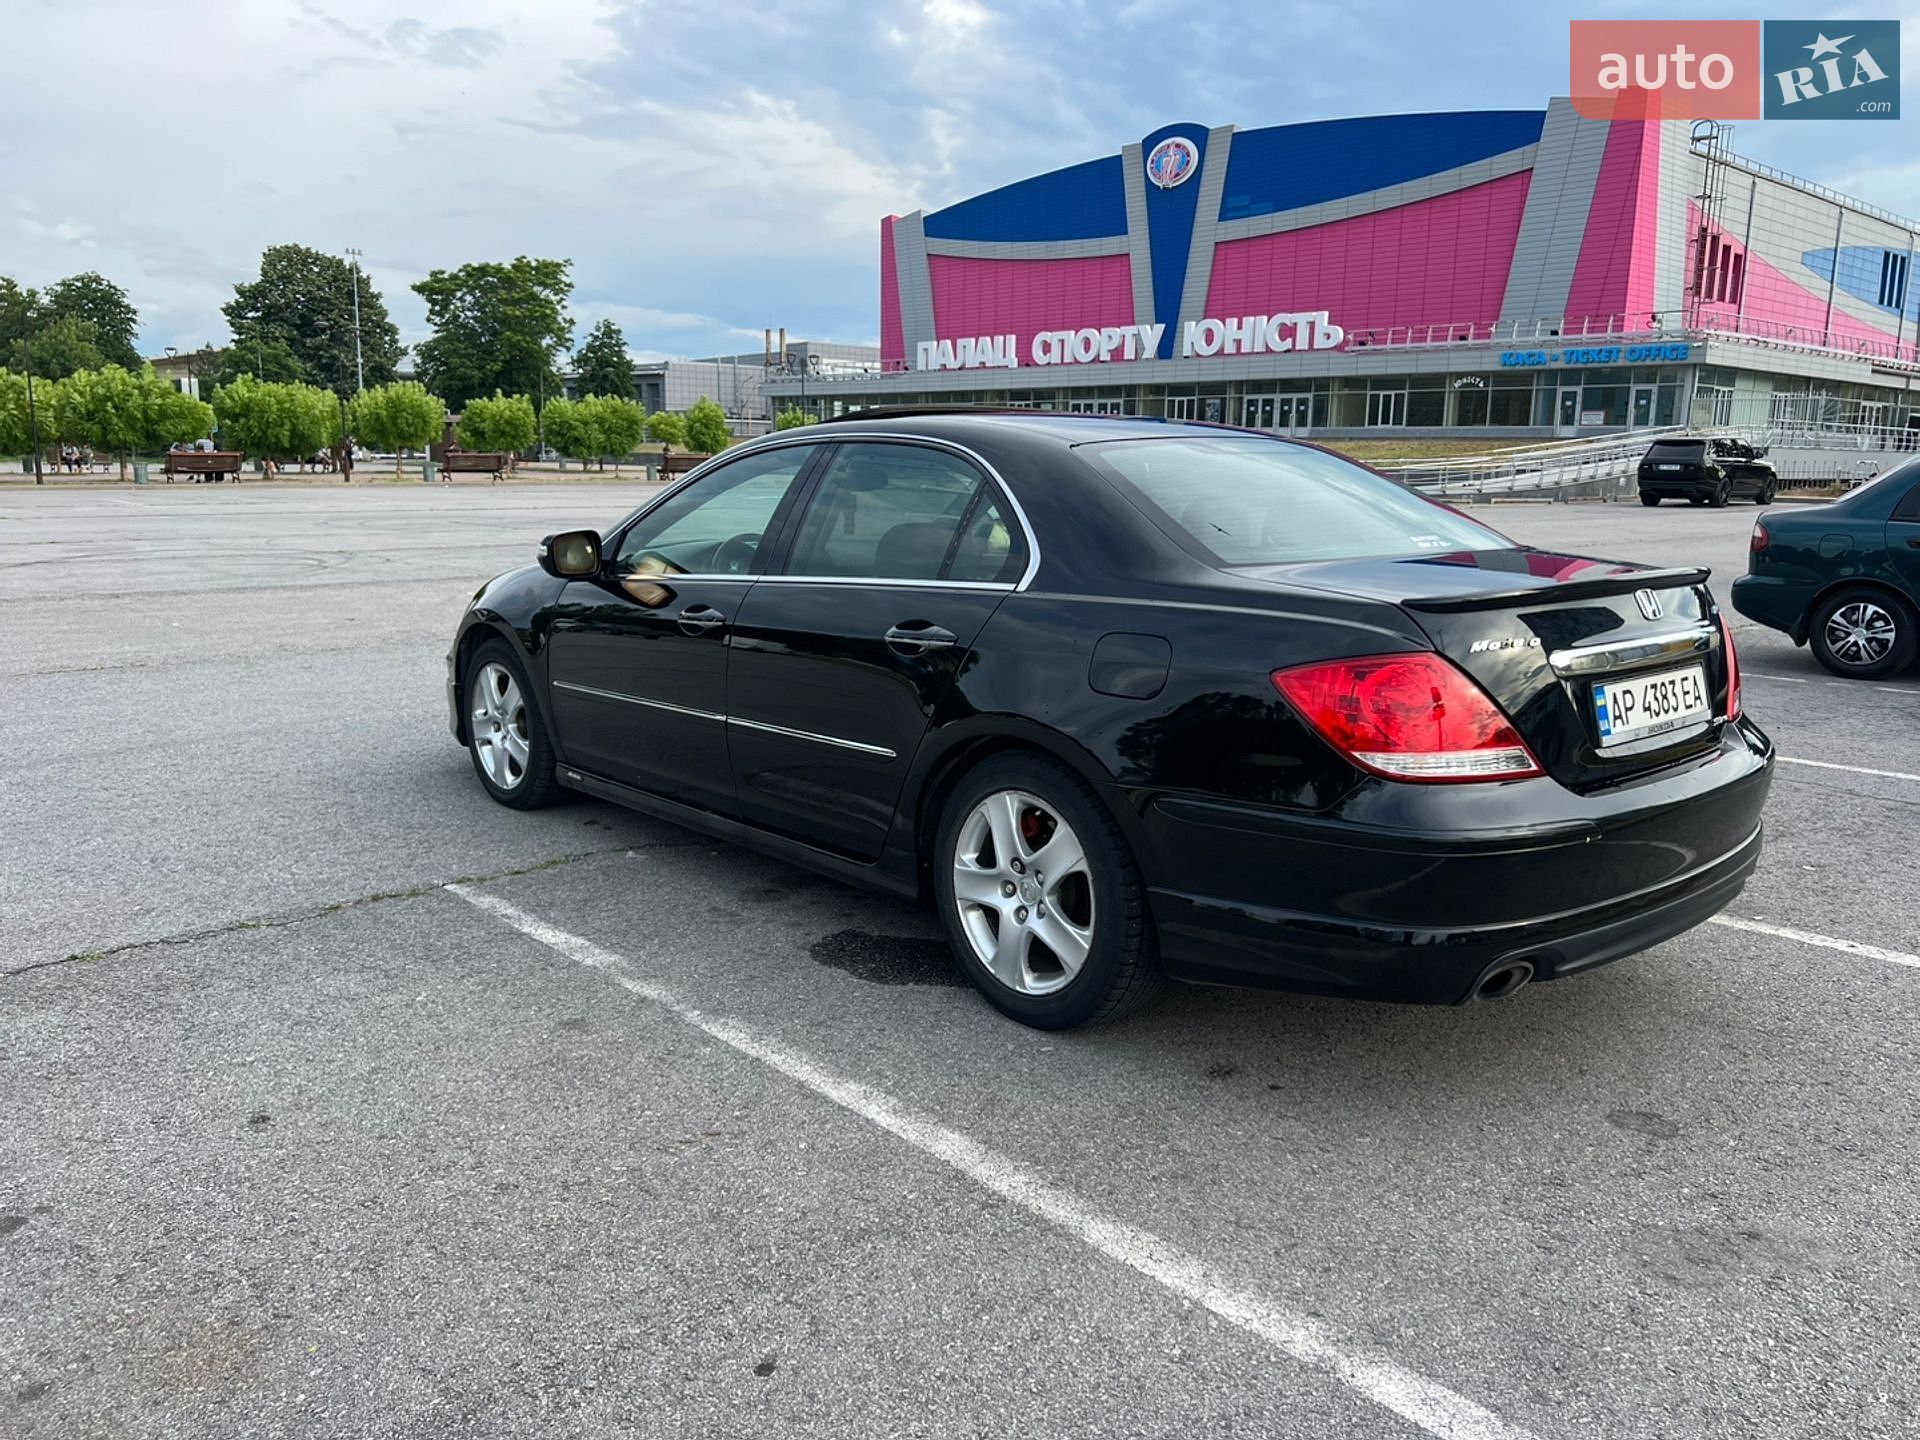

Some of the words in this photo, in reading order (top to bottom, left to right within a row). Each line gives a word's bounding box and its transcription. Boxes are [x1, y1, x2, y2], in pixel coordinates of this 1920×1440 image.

[917, 334, 1018, 371] ПАЛАЦ
[1032, 323, 1166, 366] СПОРТУ
[1182, 310, 1344, 359] ЮНІСТЬ
[1501, 351, 1547, 367] КАСА
[1564, 347, 1622, 364] TICKET
[1626, 344, 1689, 362] OFFICE
[1612, 689, 1635, 728] AP
[1643, 678, 1679, 720] 4383
[1681, 675, 1703, 710] EA
